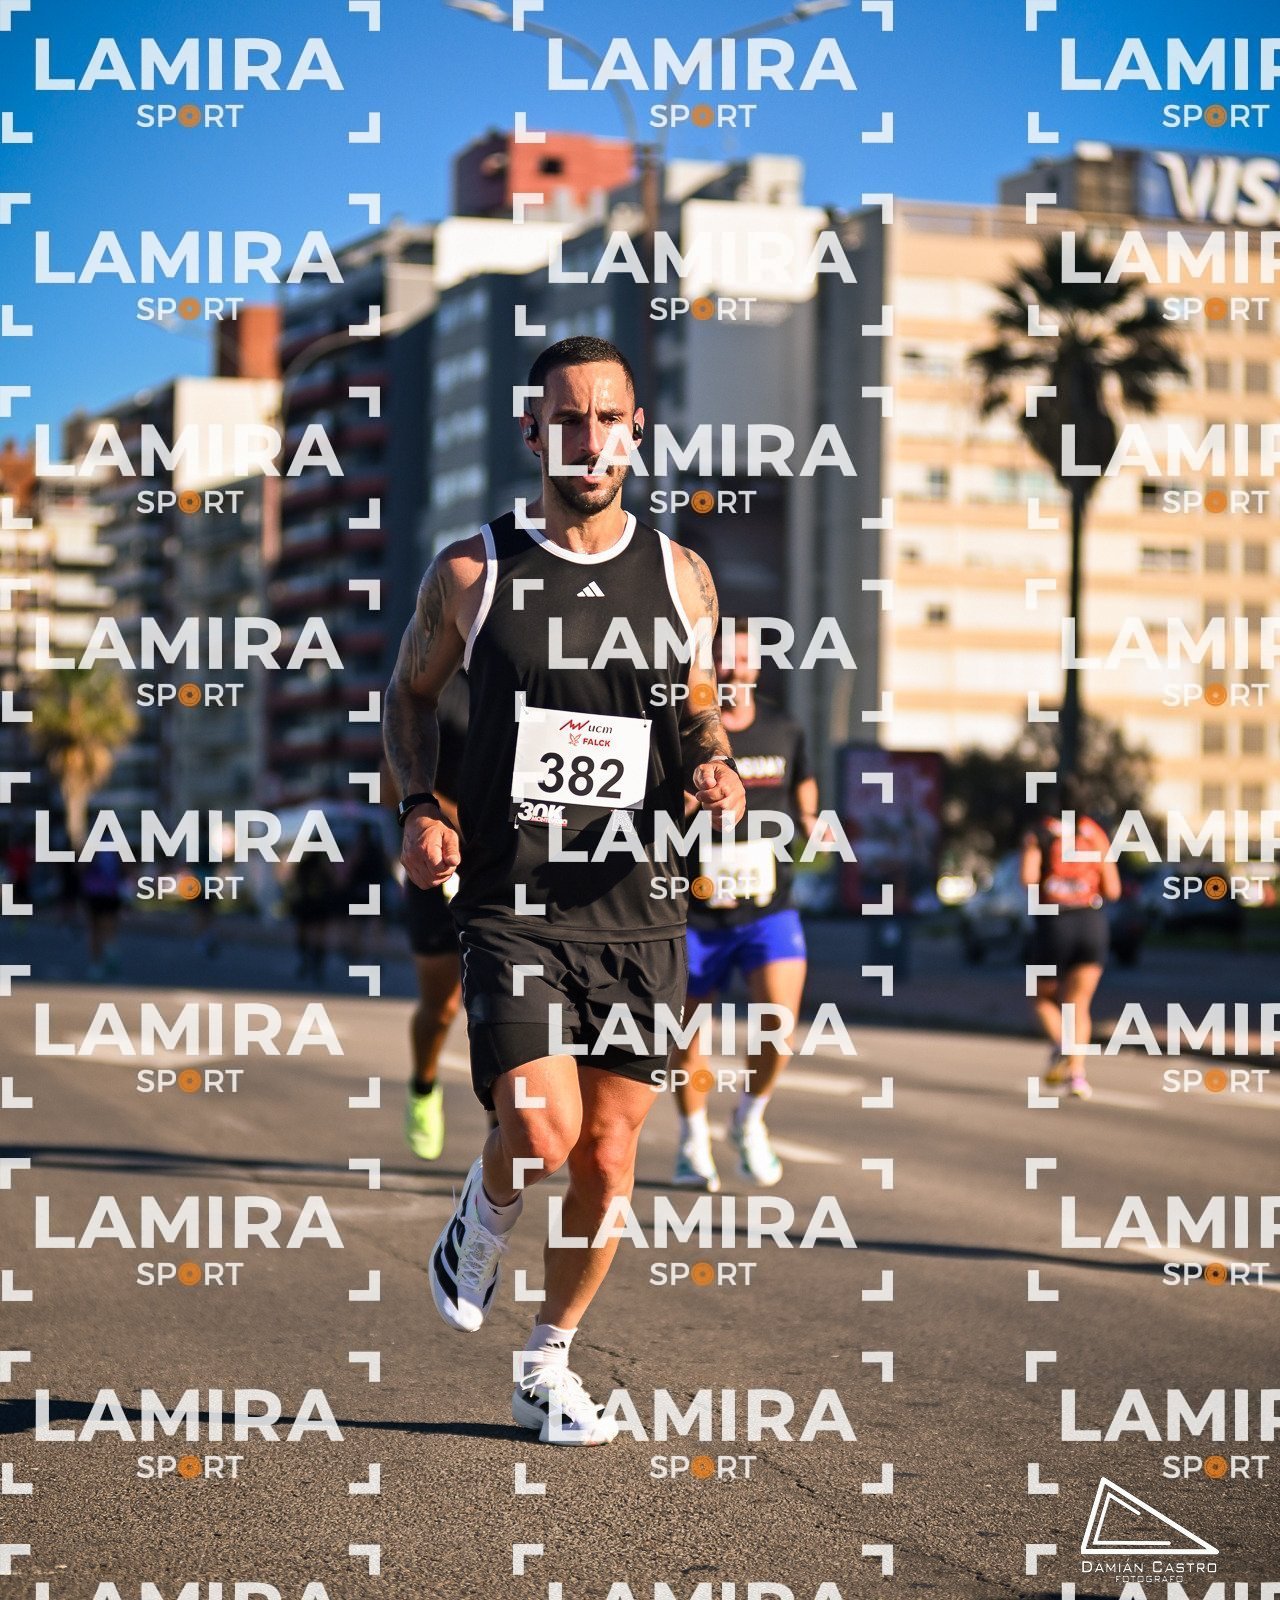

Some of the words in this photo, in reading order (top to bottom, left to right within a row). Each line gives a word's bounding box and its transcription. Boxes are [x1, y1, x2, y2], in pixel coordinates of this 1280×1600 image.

[1155, 150, 1280, 226] VIS
[582, 737, 611, 747] FALCK
[537, 752, 625, 799] 382
[517, 801, 566, 821] 30K
